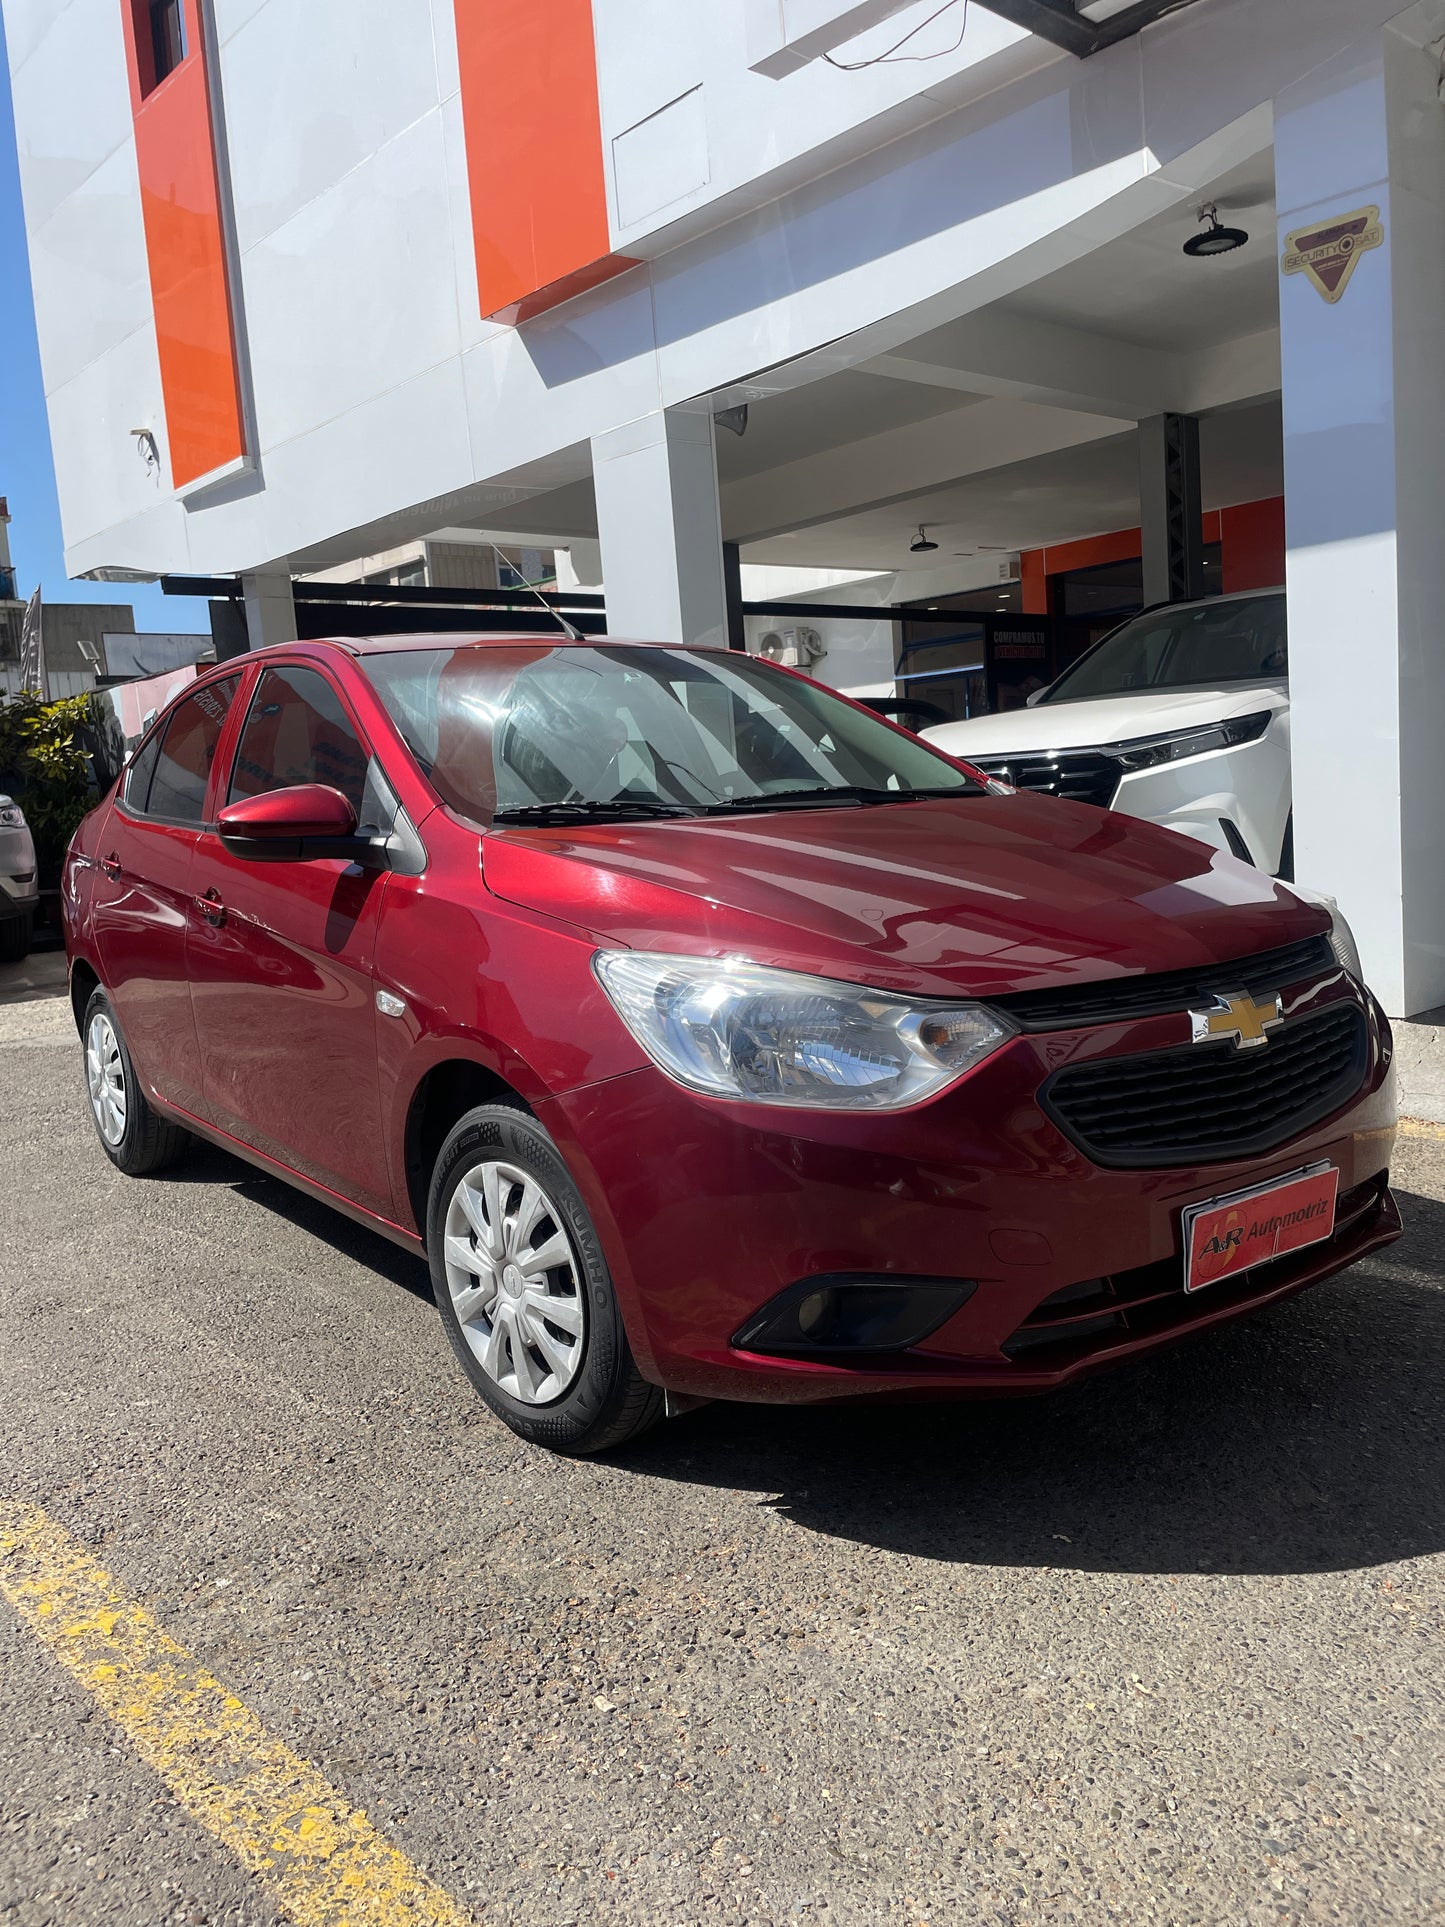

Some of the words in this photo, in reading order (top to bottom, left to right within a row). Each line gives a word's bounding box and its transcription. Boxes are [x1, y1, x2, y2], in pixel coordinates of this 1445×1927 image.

[1287, 245, 1338, 267] SECURITY
[993, 631, 1036, 643] COMPRAMOS
[561, 1187, 608, 1309] KUMHO
[1198, 1227, 1245, 1260] A&R
[1246, 1198, 1329, 1242] Automotriz
